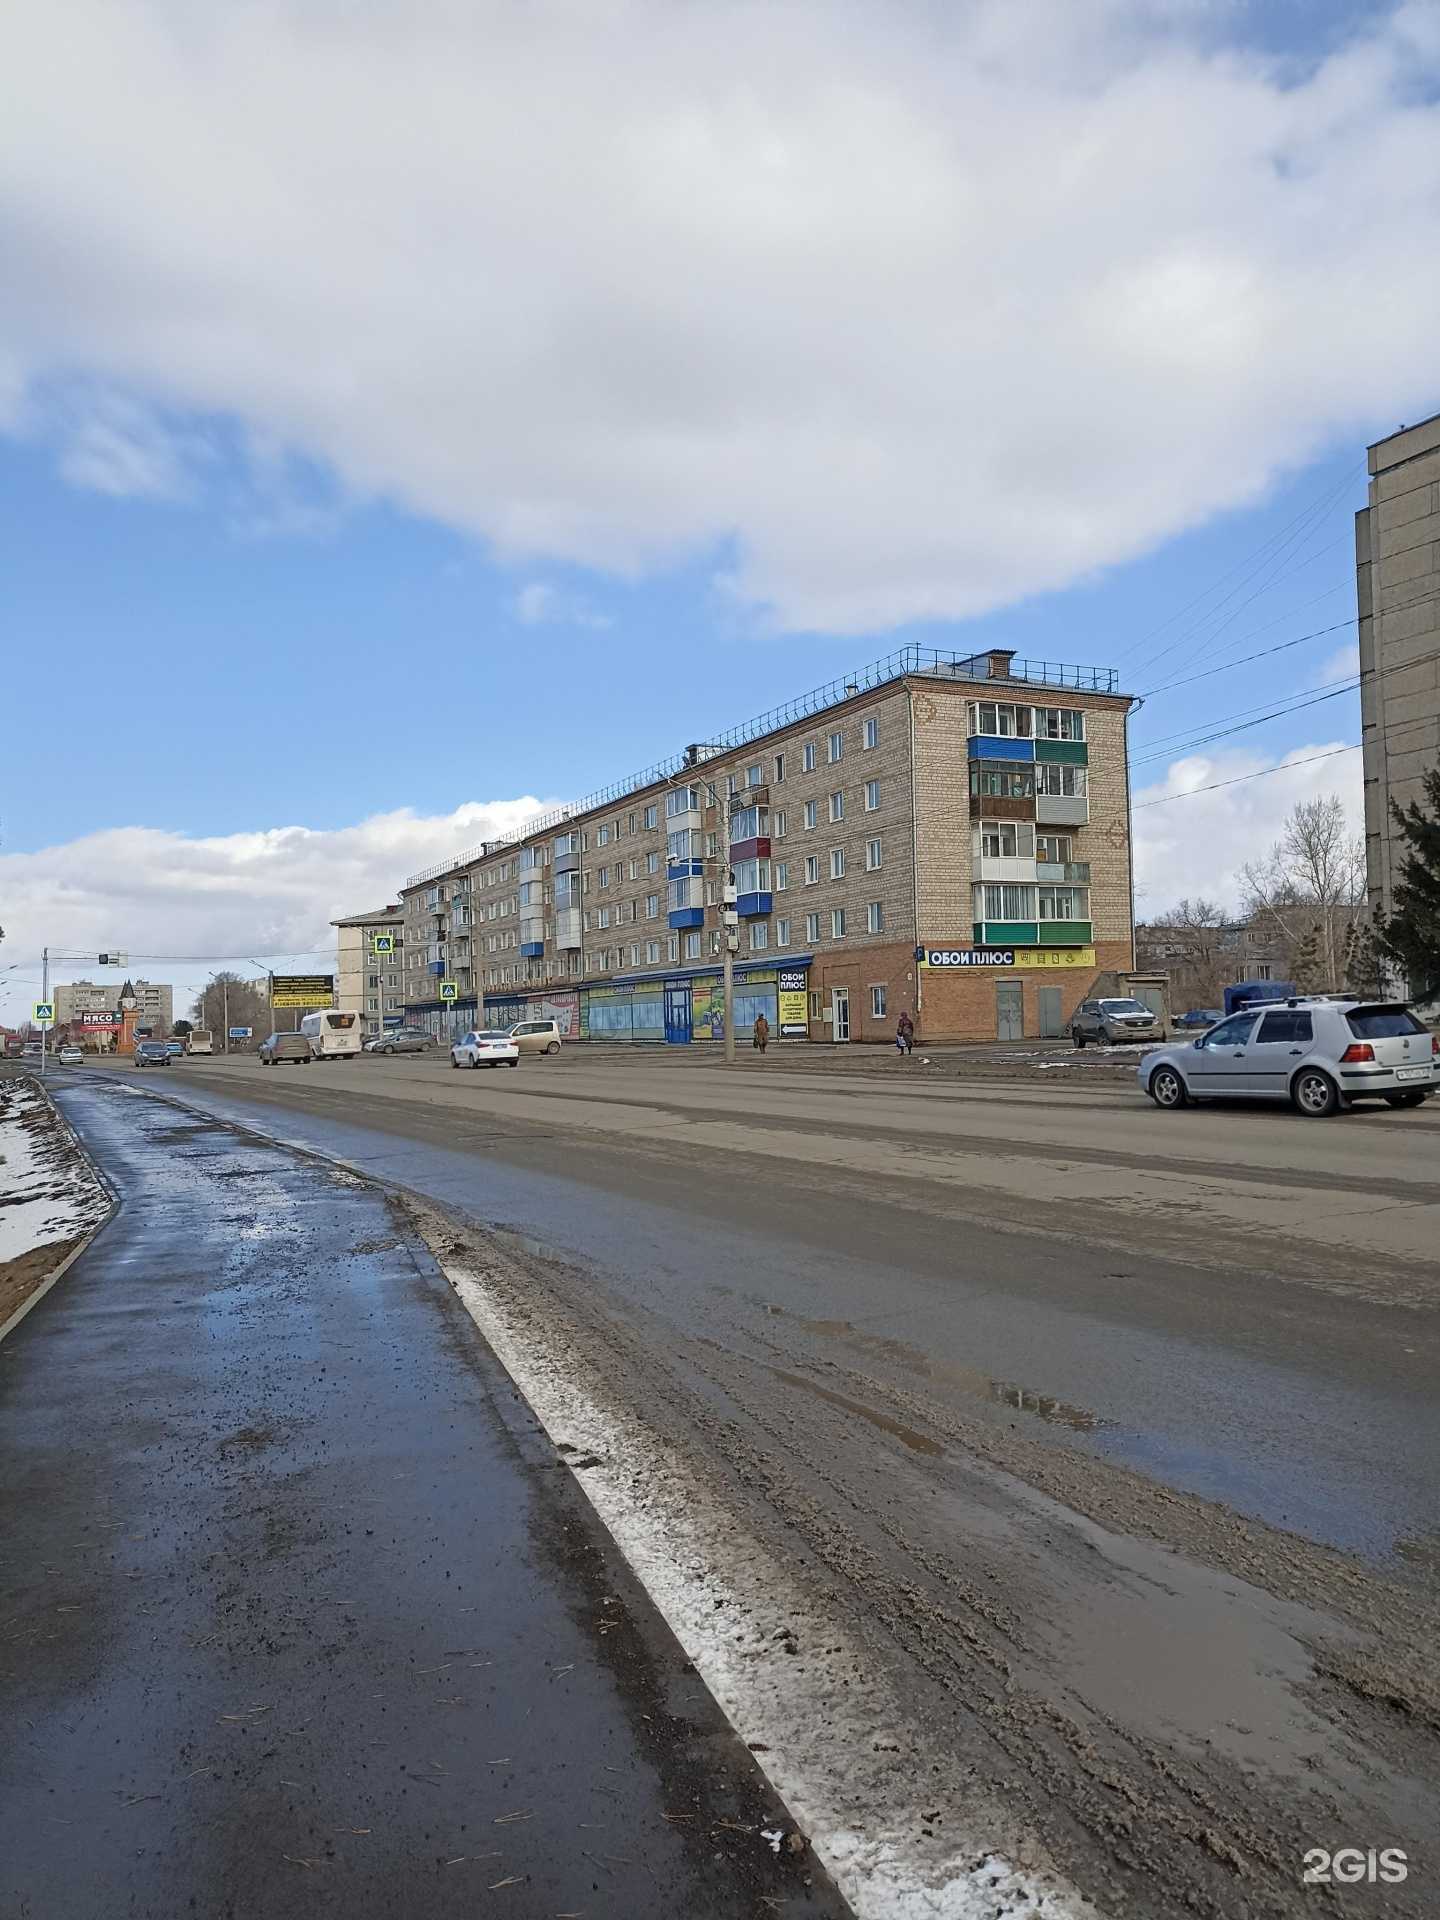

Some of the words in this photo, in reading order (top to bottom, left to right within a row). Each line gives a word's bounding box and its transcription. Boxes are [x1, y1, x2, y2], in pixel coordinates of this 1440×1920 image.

[931, 952, 969, 965] ОБОИ
[972, 952, 1012, 965] ПЛЮС
[781, 973, 804, 981] ОБОИ
[780, 981, 805, 989] ПЛЮС
[83, 1014, 113, 1022] МЯСО
